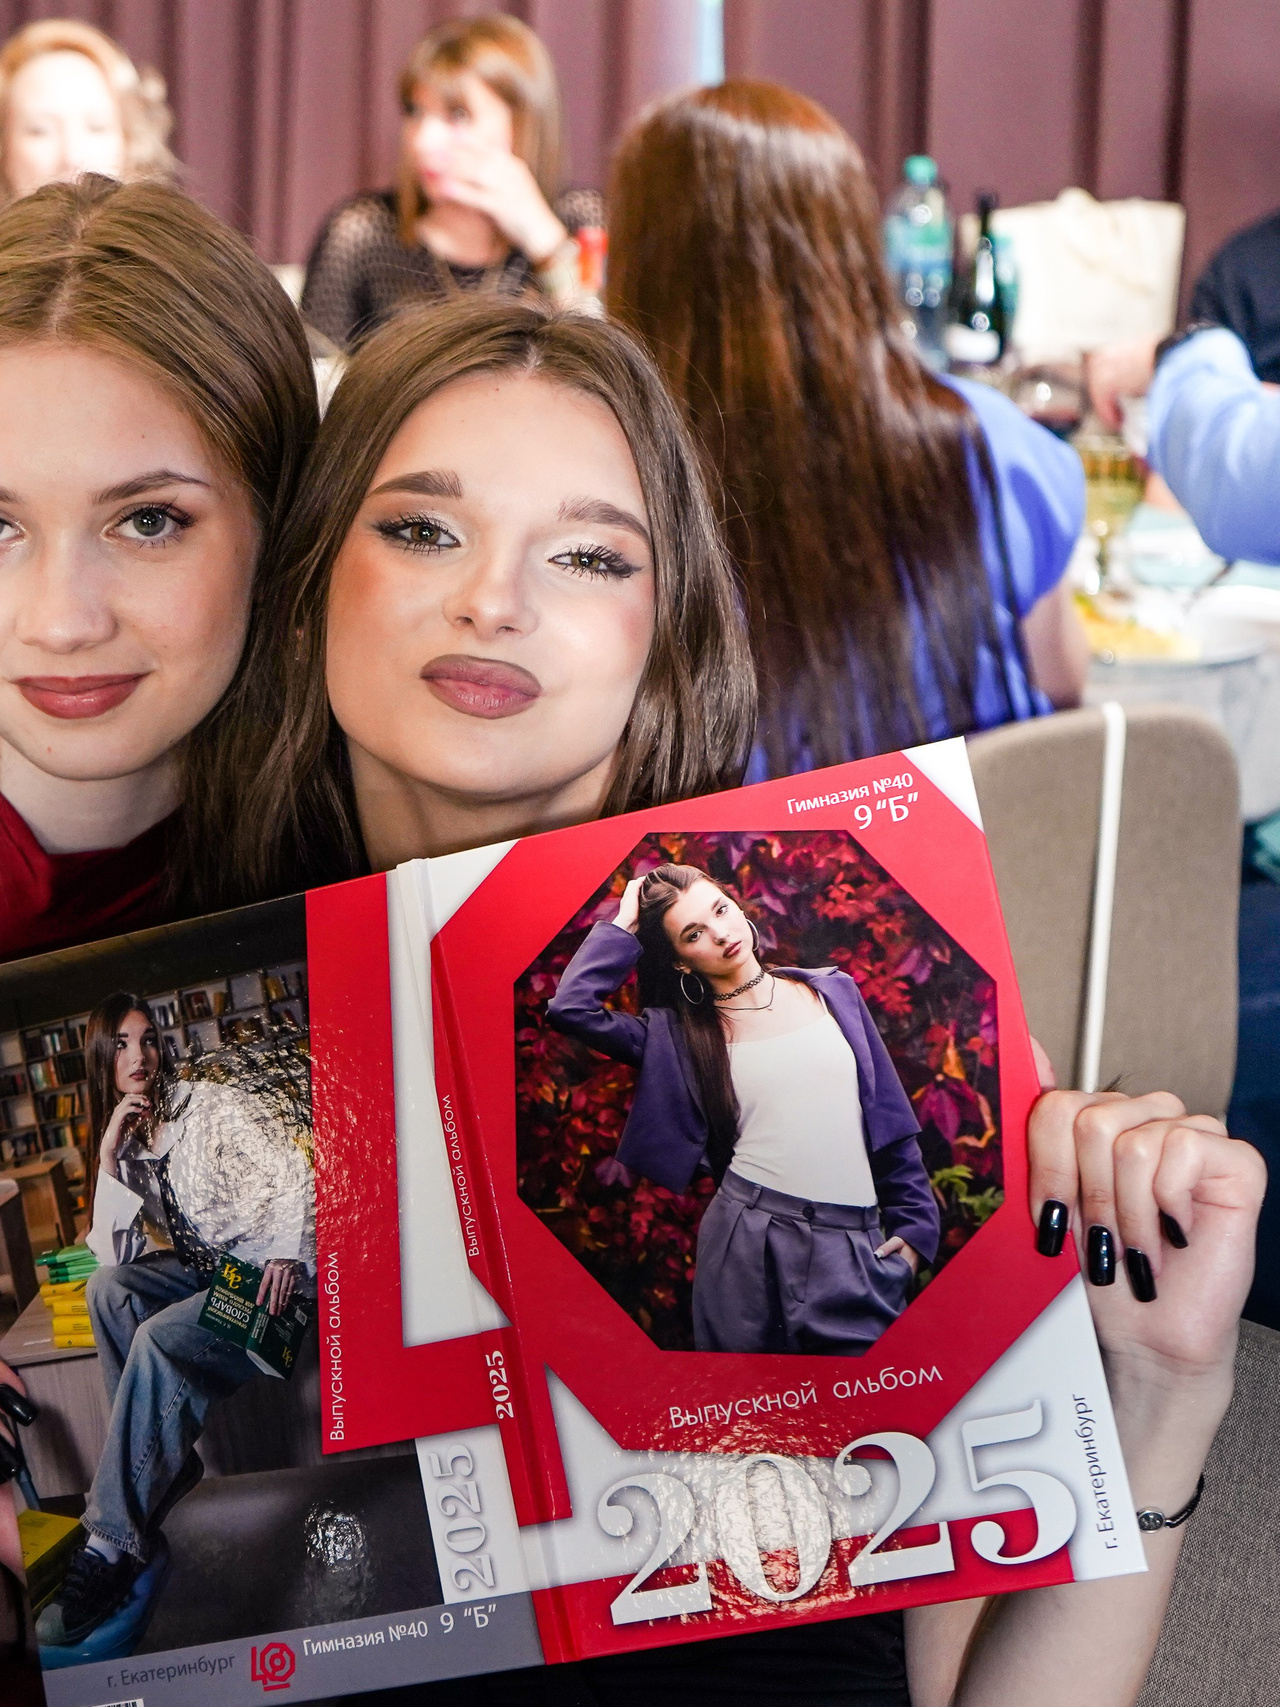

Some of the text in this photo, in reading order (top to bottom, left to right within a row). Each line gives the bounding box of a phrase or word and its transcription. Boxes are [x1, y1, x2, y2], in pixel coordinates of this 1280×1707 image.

[787, 773, 914, 814] Гимназия №40
[854, 804, 873, 830] 9
[442, 1094, 480, 1257] Выпускной альбом
[211, 1297, 250, 1323] СЛОВАРЬ
[324, 1251, 347, 1441] Выпускной альбом
[485, 1350, 514, 1420] 2025
[669, 1365, 944, 1429] Выпускной альбом
[1072, 1394, 1115, 1533] Екатеринбург
[428, 1444, 496, 1591] 2025
[597, 1399, 1078, 1626] 2025
[303, 1630, 385, 1656] Гимназия
[388, 1620, 429, 1642] №40
[439, 1612, 455, 1634] 9
[121, 1655, 236, 1686] Екатеринбург
